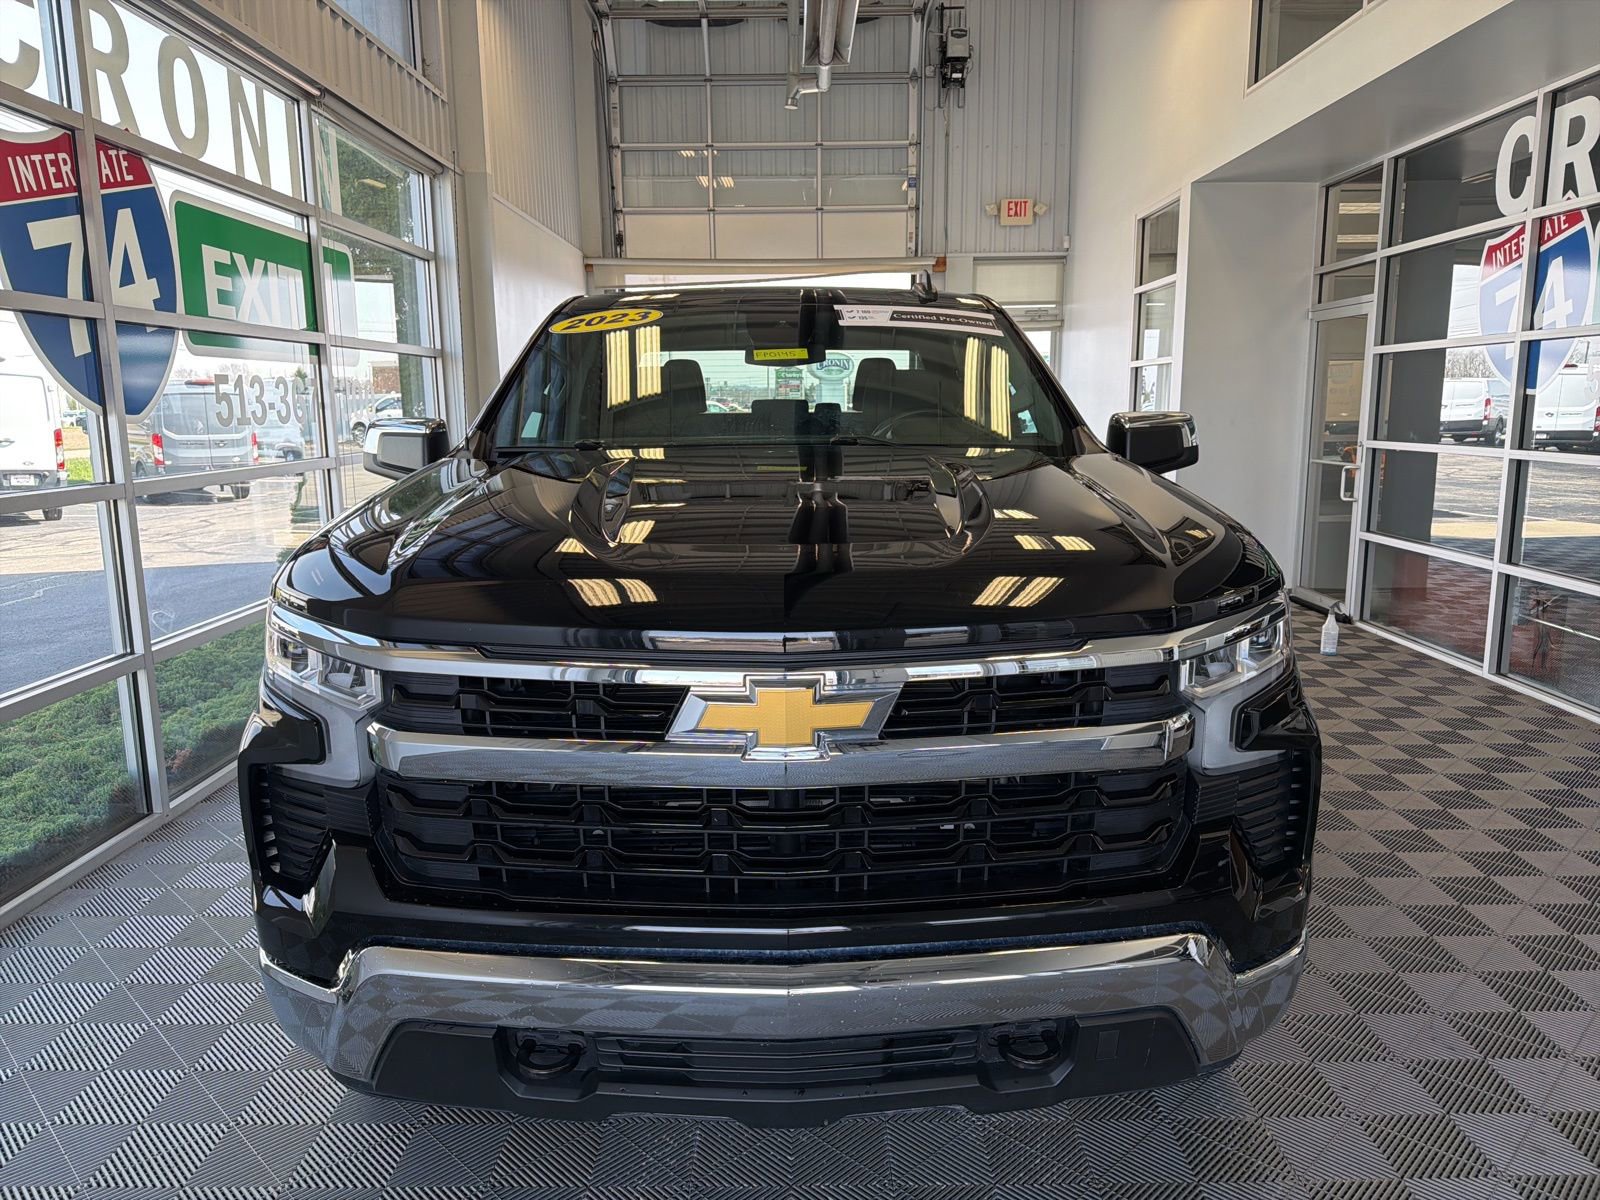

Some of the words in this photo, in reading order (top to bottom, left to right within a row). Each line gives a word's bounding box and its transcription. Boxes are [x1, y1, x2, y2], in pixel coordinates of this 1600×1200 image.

[8, 150, 134, 194] INTERATE
[1007, 201, 1028, 217] EXIT
[1491, 214, 1570, 271] INTERATE
[27, 208, 161, 358] 74
[201, 244, 307, 331] EXIT
[1495, 255, 1574, 361] 74
[562, 311, 652, 330] 2023
[893, 313, 937, 321] Certified
[939, 316, 993, 327] Pre-Owned
